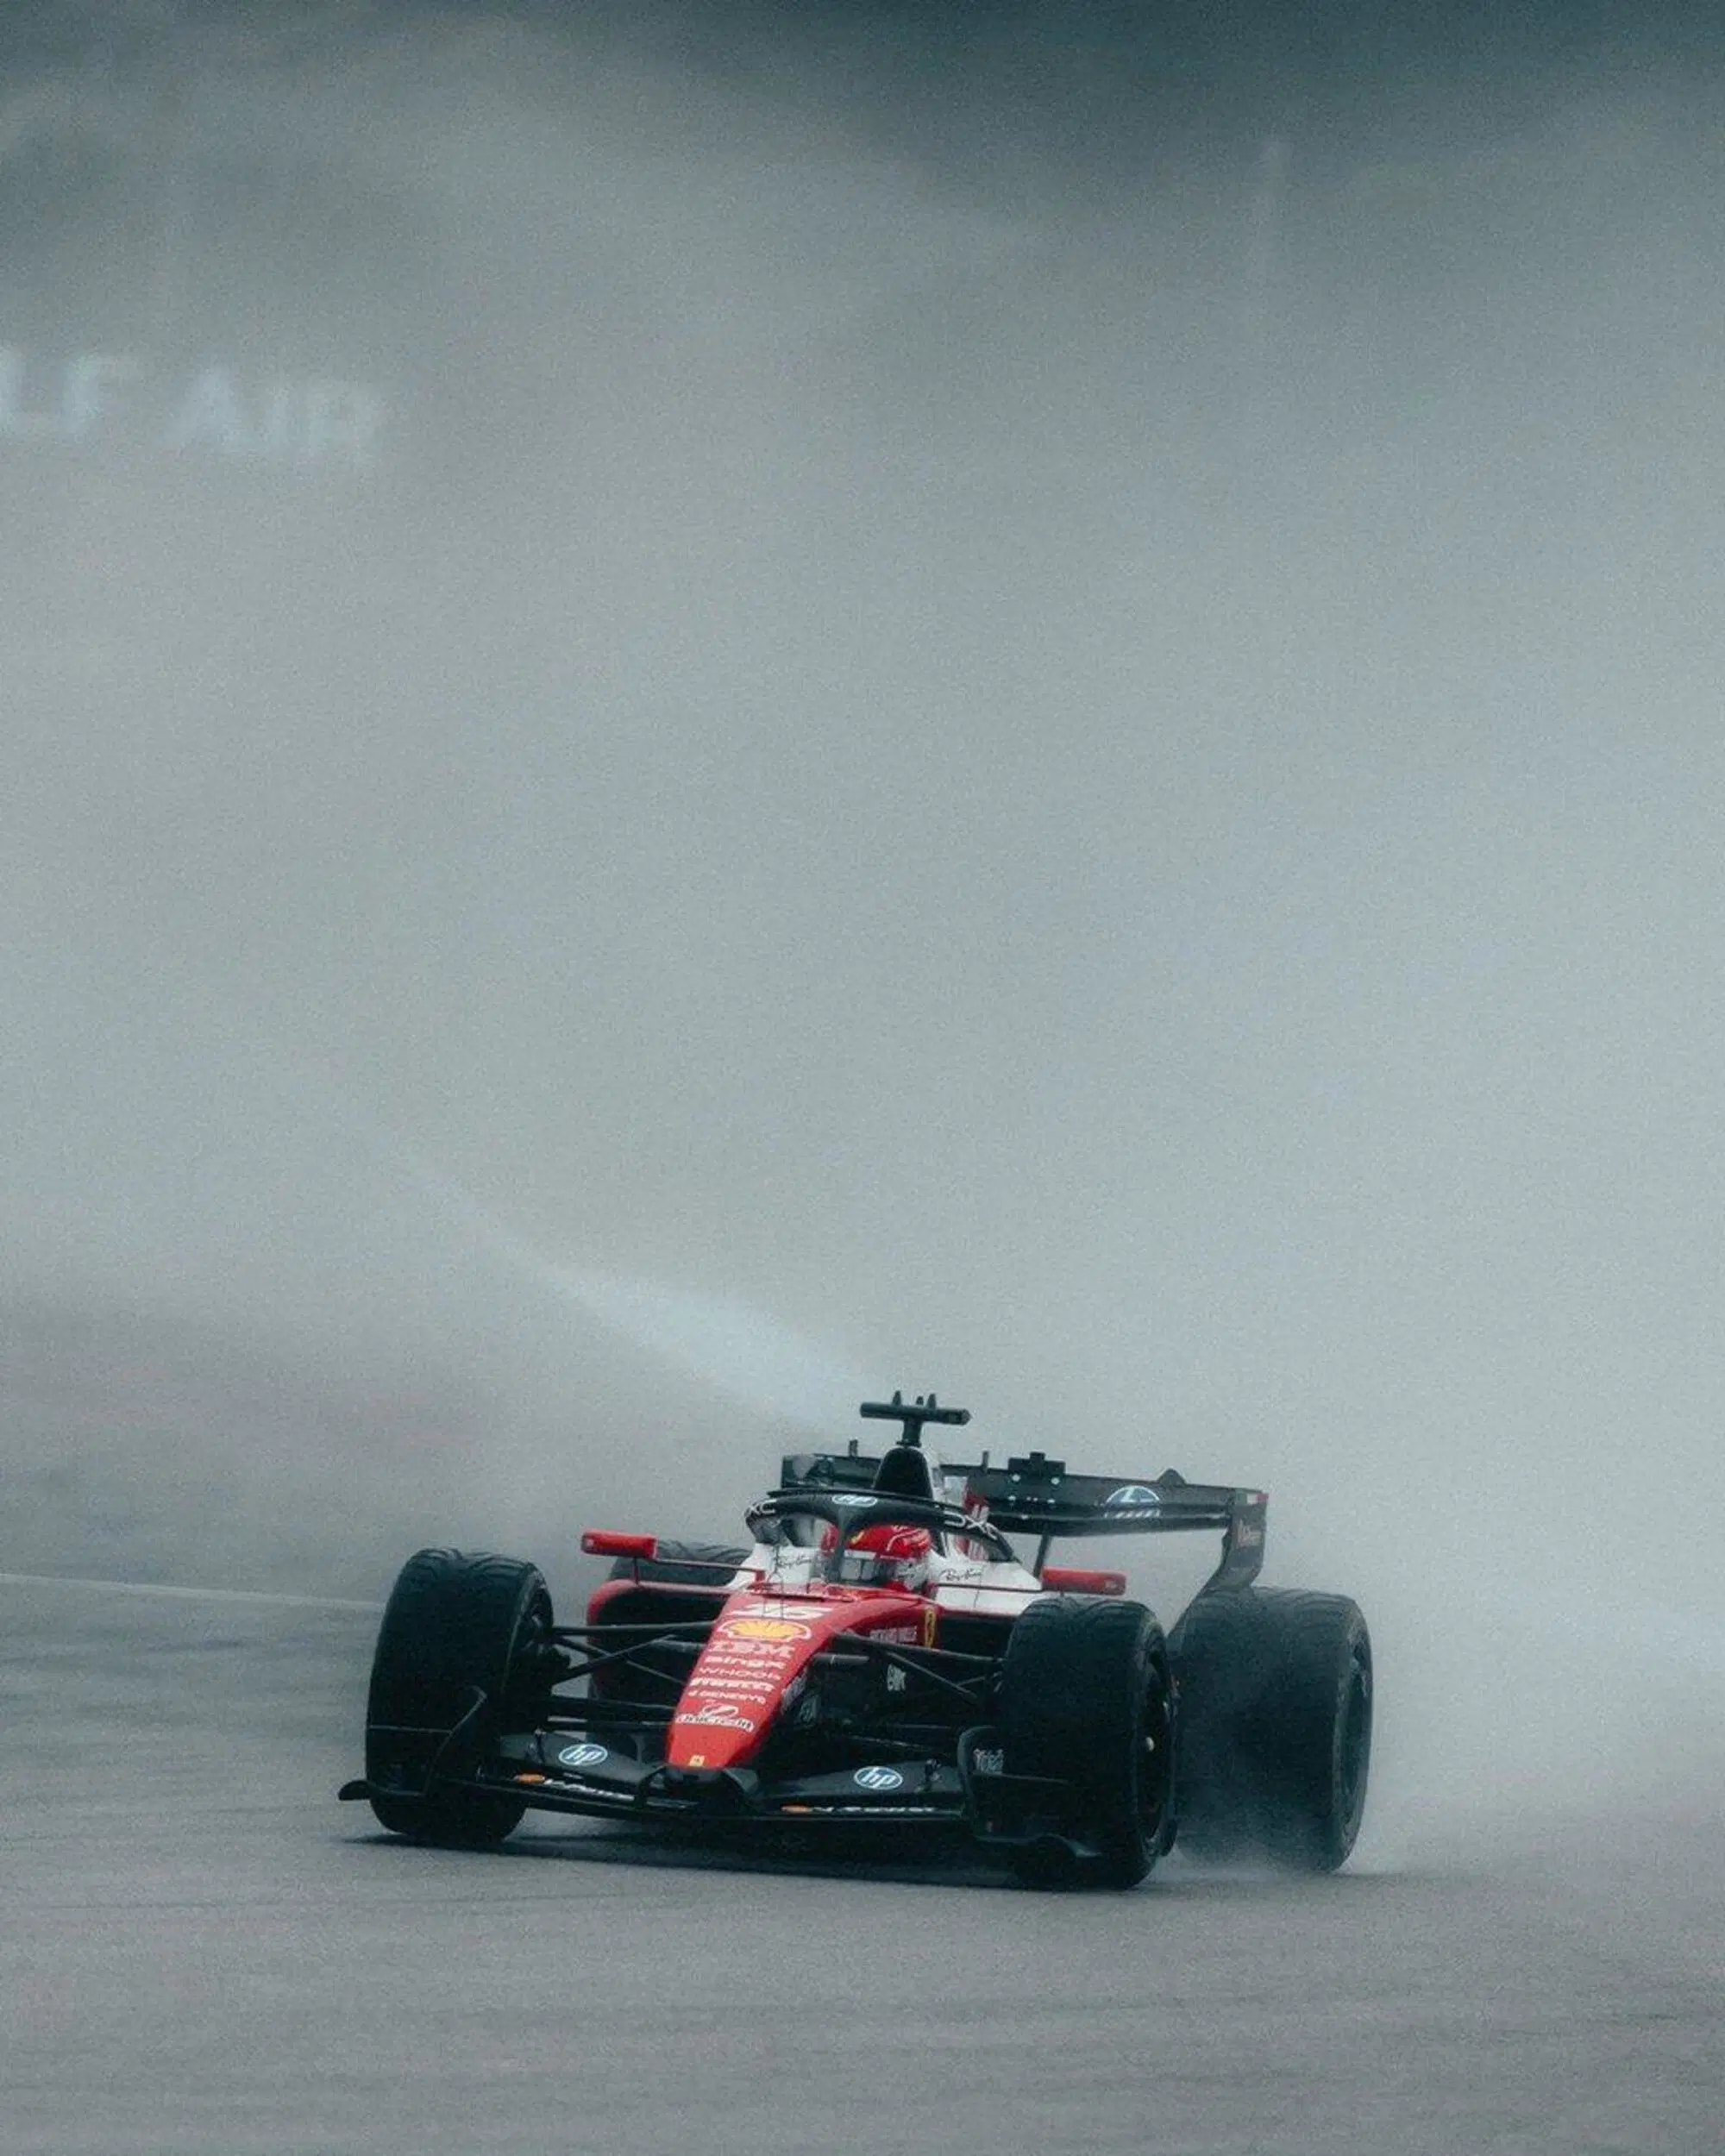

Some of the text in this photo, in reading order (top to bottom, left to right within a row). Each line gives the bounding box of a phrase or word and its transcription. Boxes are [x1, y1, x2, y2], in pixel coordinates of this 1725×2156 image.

[160, 366, 386, 461] AIR
[744, 1499, 777, 1517] XC
[838, 1495, 872, 1507] hp
[943, 1510, 999, 1540] DXC
[710, 1640, 796, 1659] IBM
[568, 1745, 604, 1766] hp
[862, 1766, 897, 1790] hp
